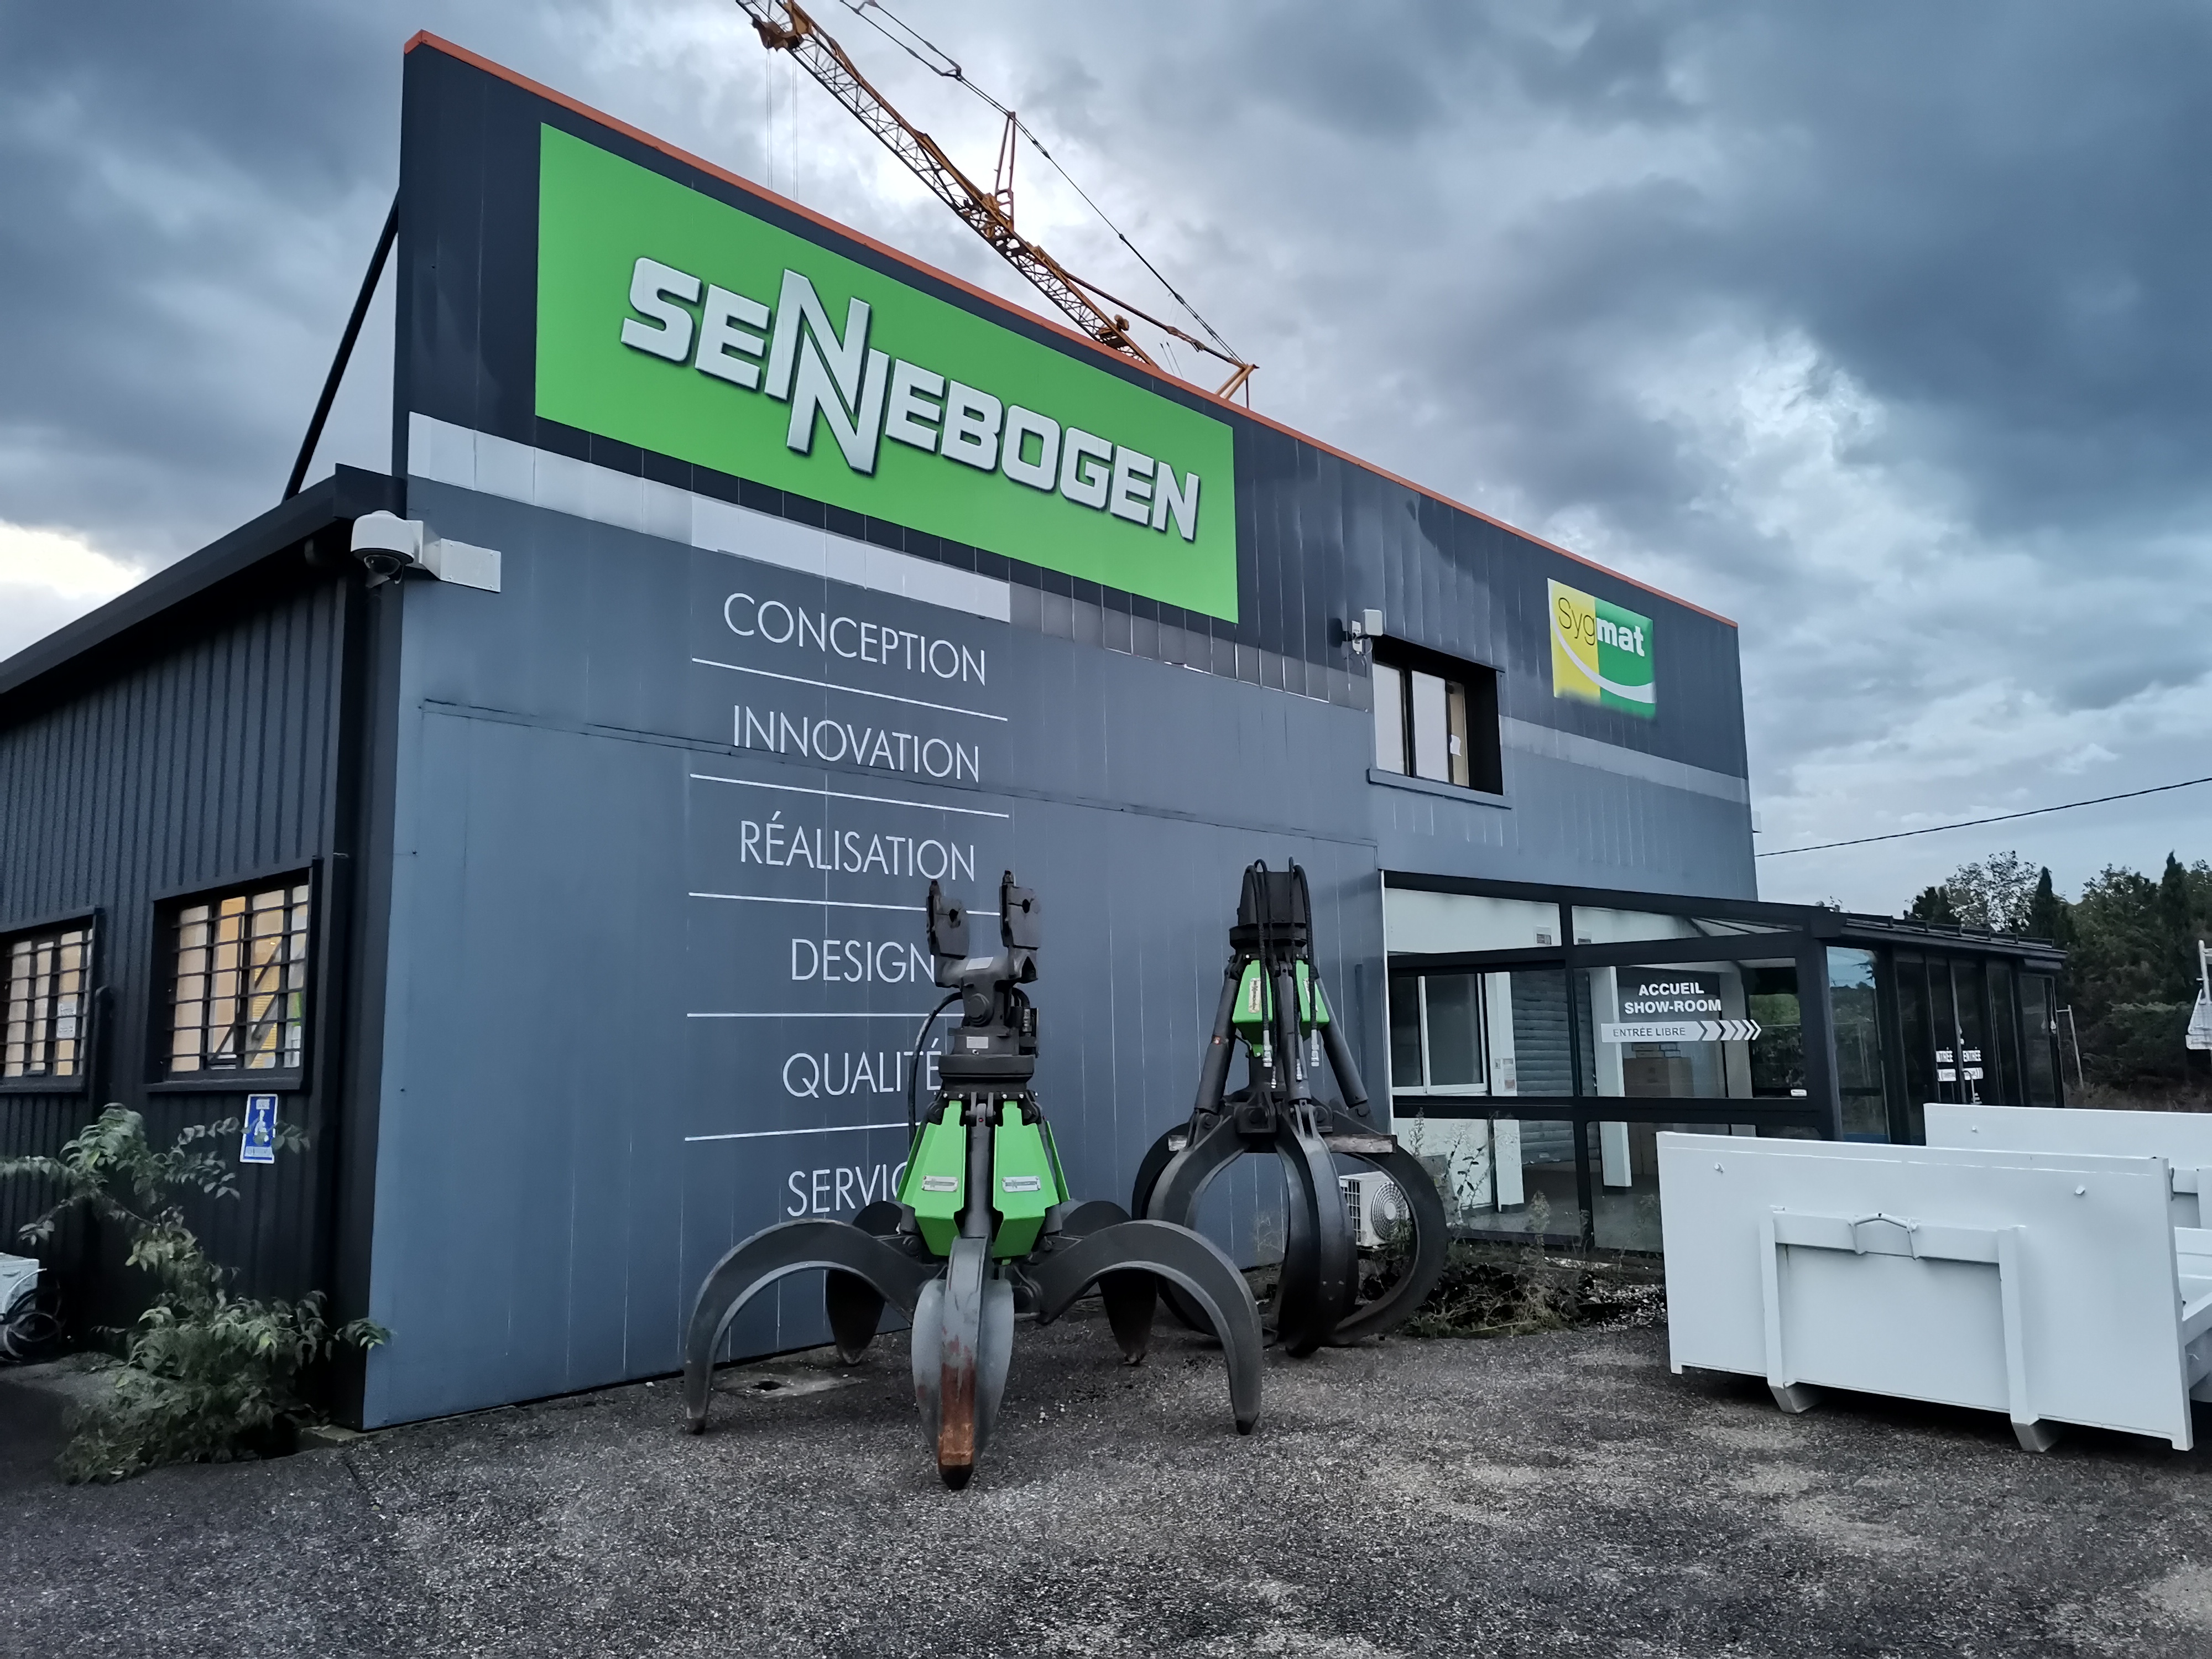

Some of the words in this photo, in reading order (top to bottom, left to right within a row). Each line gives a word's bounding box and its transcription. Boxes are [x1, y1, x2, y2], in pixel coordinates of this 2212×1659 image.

[620, 256, 1200, 542] SENNEBOGEN
[723, 593, 985, 686] CONCEPTION
[1558, 597, 1645, 657] Sygmat
[734, 705, 979, 783] INNOVATION
[740, 811, 974, 881] RÉALISATION
[791, 938, 935, 983] DESIGN
[1638, 982, 1704, 997] ACCUEIL
[1613, 1027, 1653, 1037] ENTRÉE
[1656, 1027, 1686, 1036] LIBRE
[1624, 999, 1721, 1014] SHOW-ROOM
